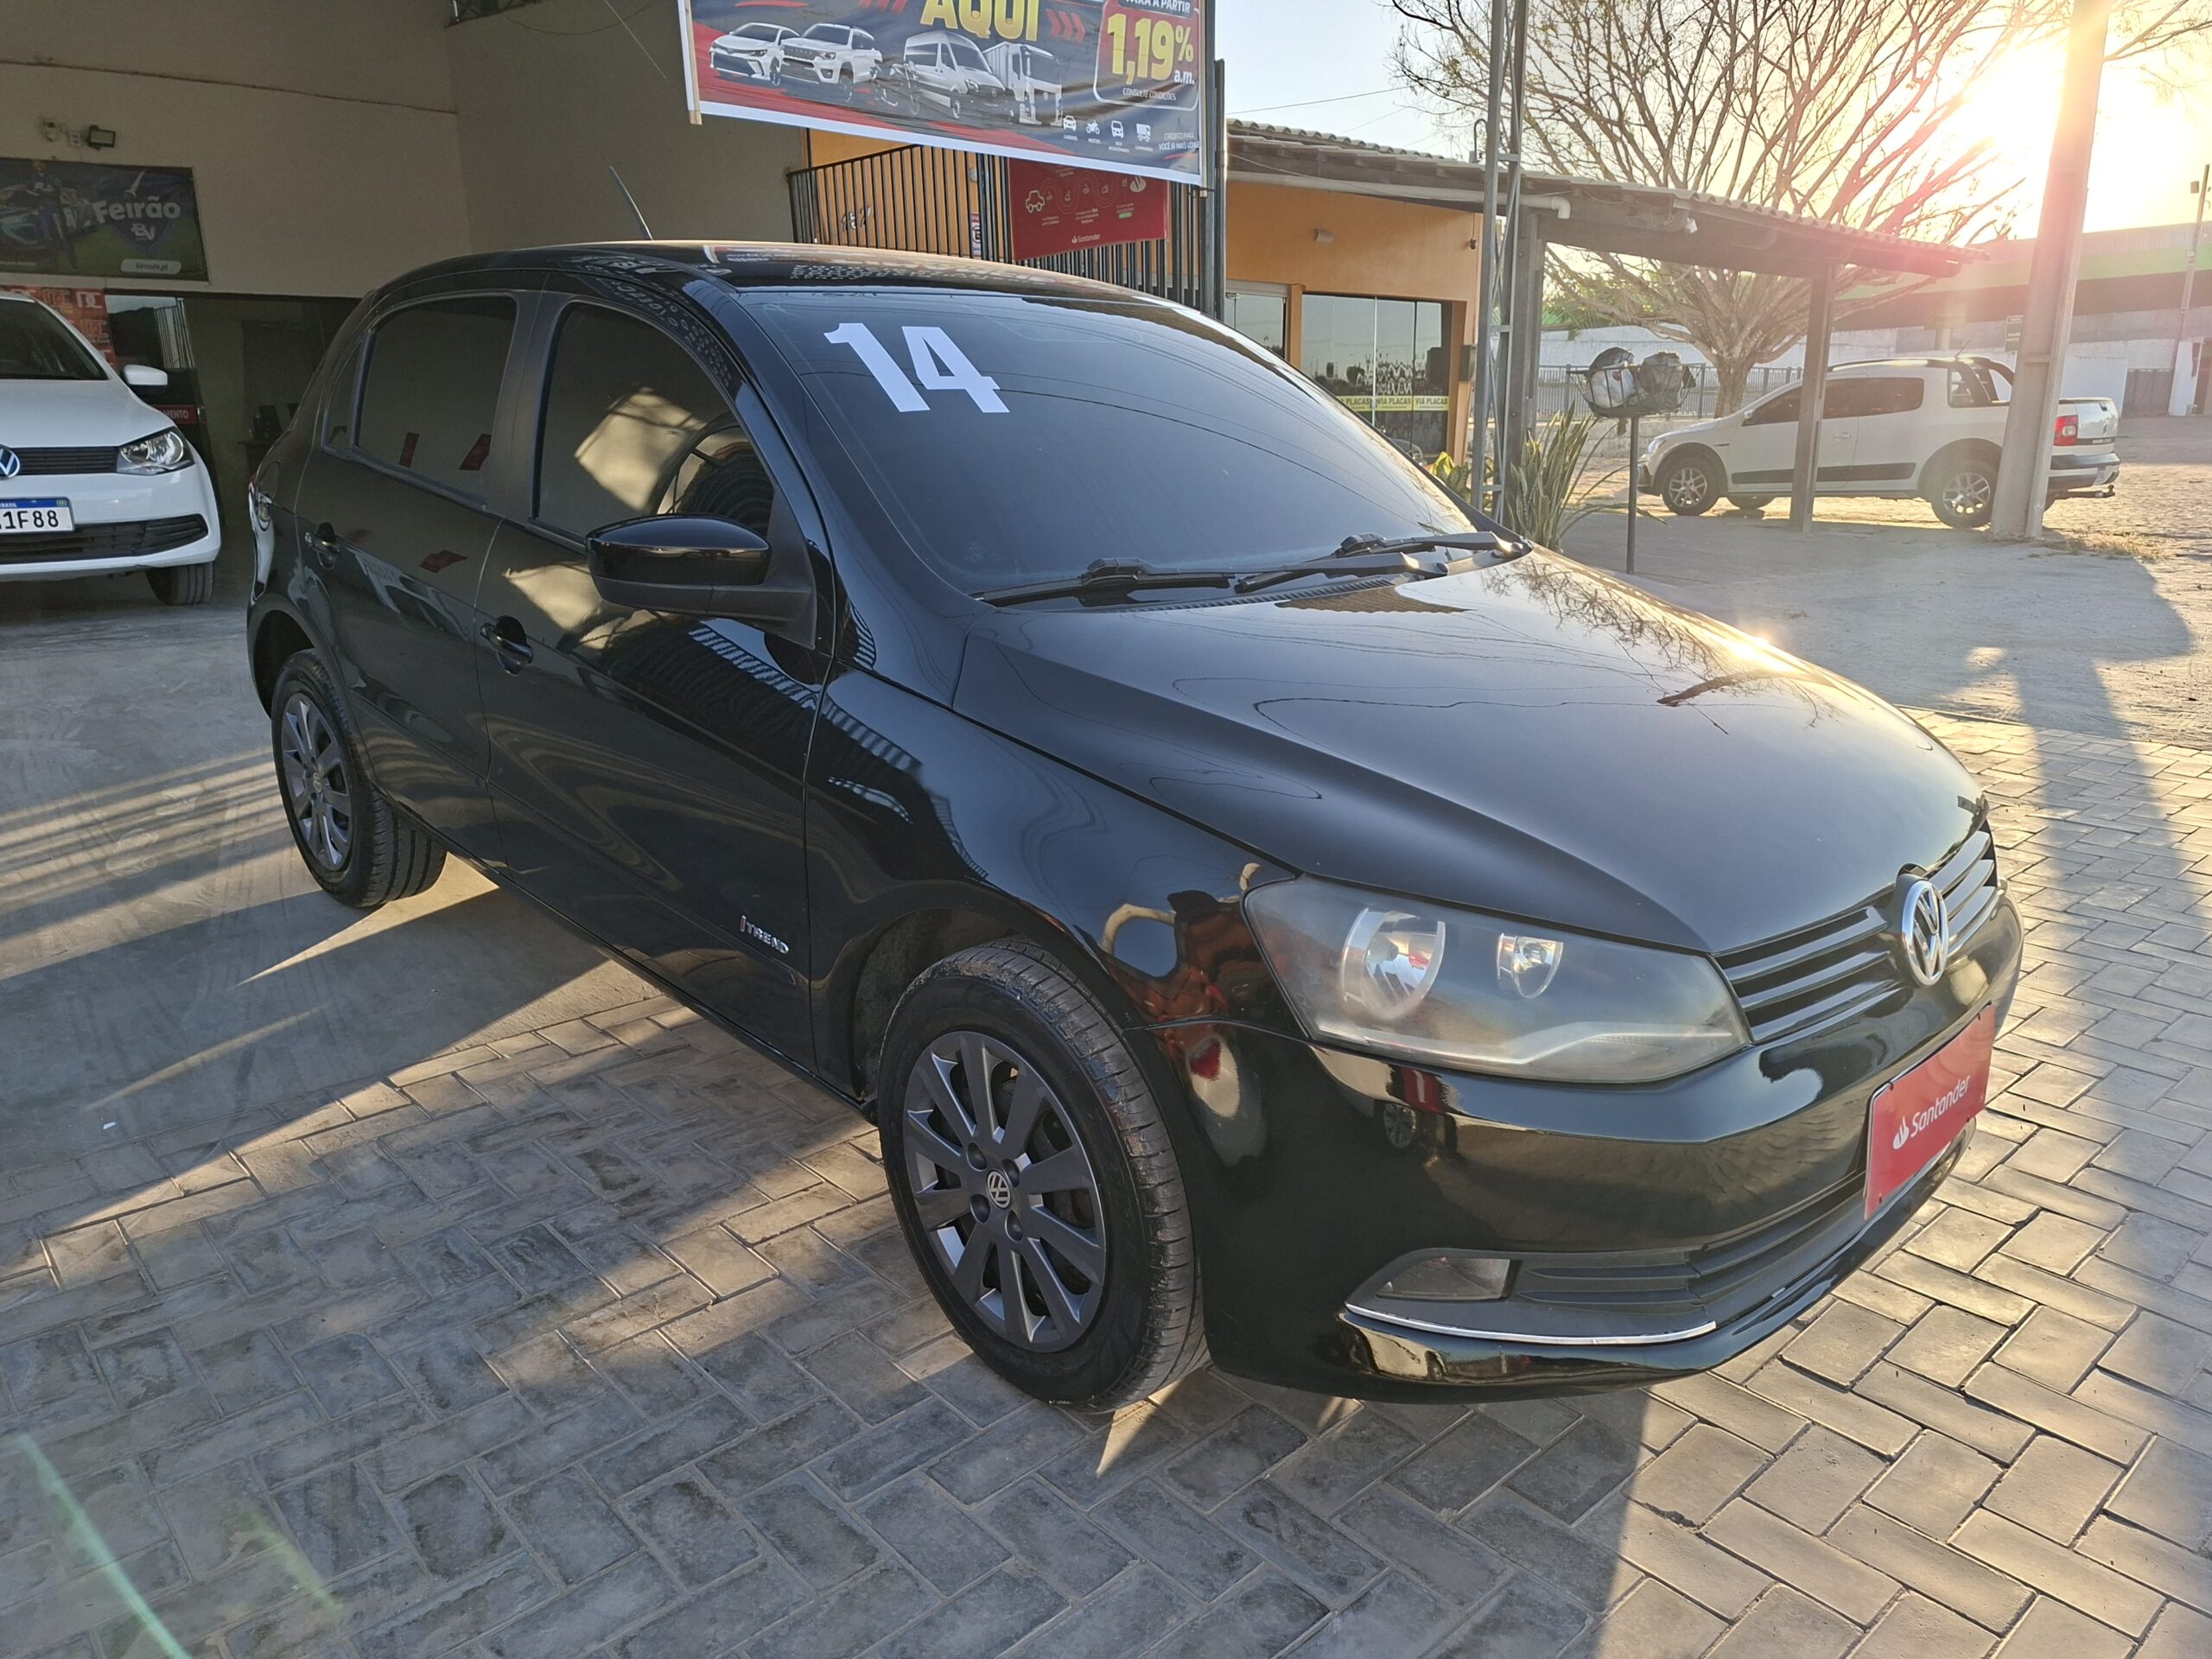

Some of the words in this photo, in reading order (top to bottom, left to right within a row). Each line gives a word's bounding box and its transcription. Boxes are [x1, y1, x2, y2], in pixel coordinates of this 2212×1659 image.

[1160, 0, 1191, 13] PARTIR
[920, 0, 1039, 41] AQUI
[1173, 70, 1195, 85] a.m.
[1122, 87, 1149, 99] CONSULTE
[1149, 91, 1177, 101] CONDIÇÕES
[92, 195, 181, 225] Feirão
[1077, 233, 1100, 243] Santander
[823, 323, 1010, 412] 14
[0, 510, 59, 530] 1F88
[1910, 1075, 1971, 1138] Santander
